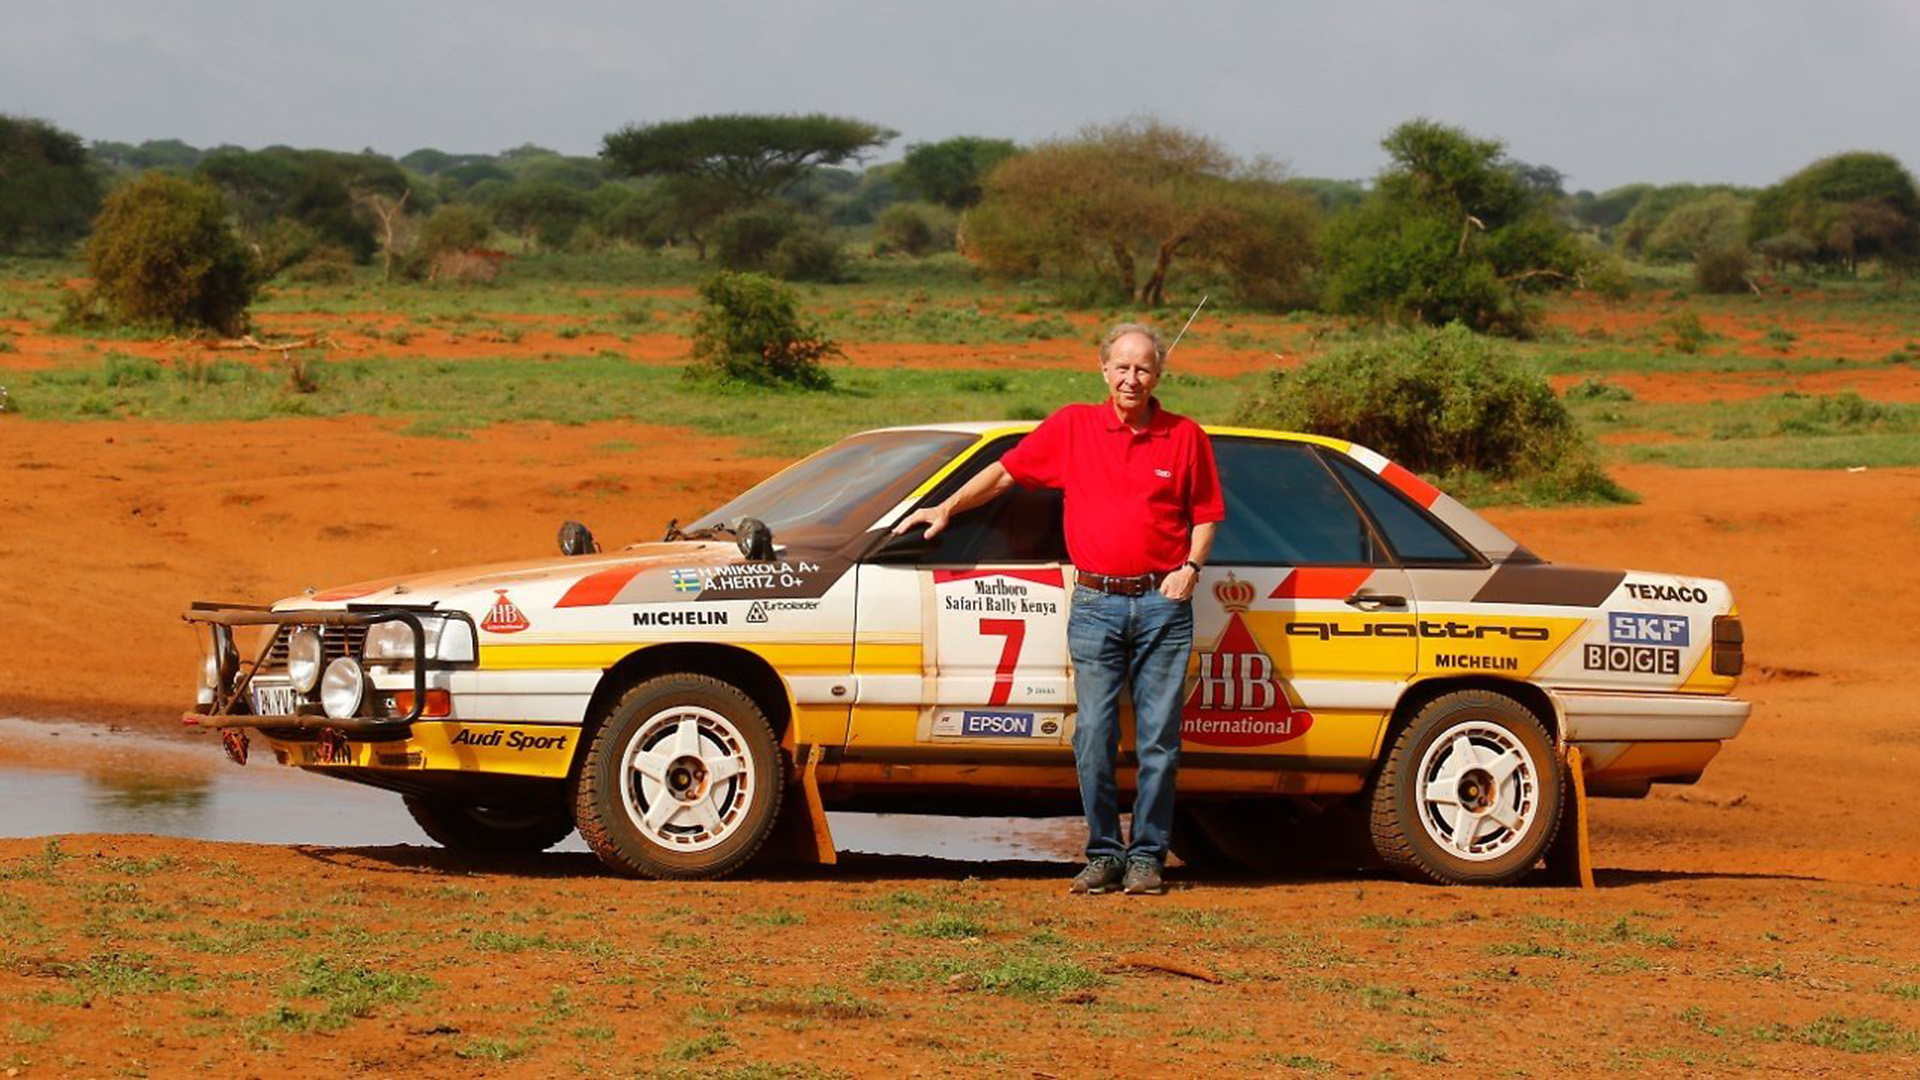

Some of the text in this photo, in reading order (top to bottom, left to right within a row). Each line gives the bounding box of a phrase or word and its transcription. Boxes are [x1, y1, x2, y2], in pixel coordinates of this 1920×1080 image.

[799, 561, 821, 573] A+
[704, 574, 775, 591] A.HERTZ
[974, 578, 1028, 596] Marlboro
[1624, 583, 1708, 604] TEXACO
[492, 603, 518, 623] HB
[945, 595, 1057, 615] Safari Rally Kenya
[632, 610, 729, 626] MICHELIN
[1285, 620, 1550, 641] quattro
[1613, 616, 1686, 642] SKF
[979, 617, 1026, 706] 7
[1435, 653, 1519, 670] MICHELIN
[1587, 646, 1676, 672] BOGE
[1199, 652, 1276, 711] HB
[969, 716, 1028, 733] EPSON
[450, 728, 568, 751] Audi Sport
